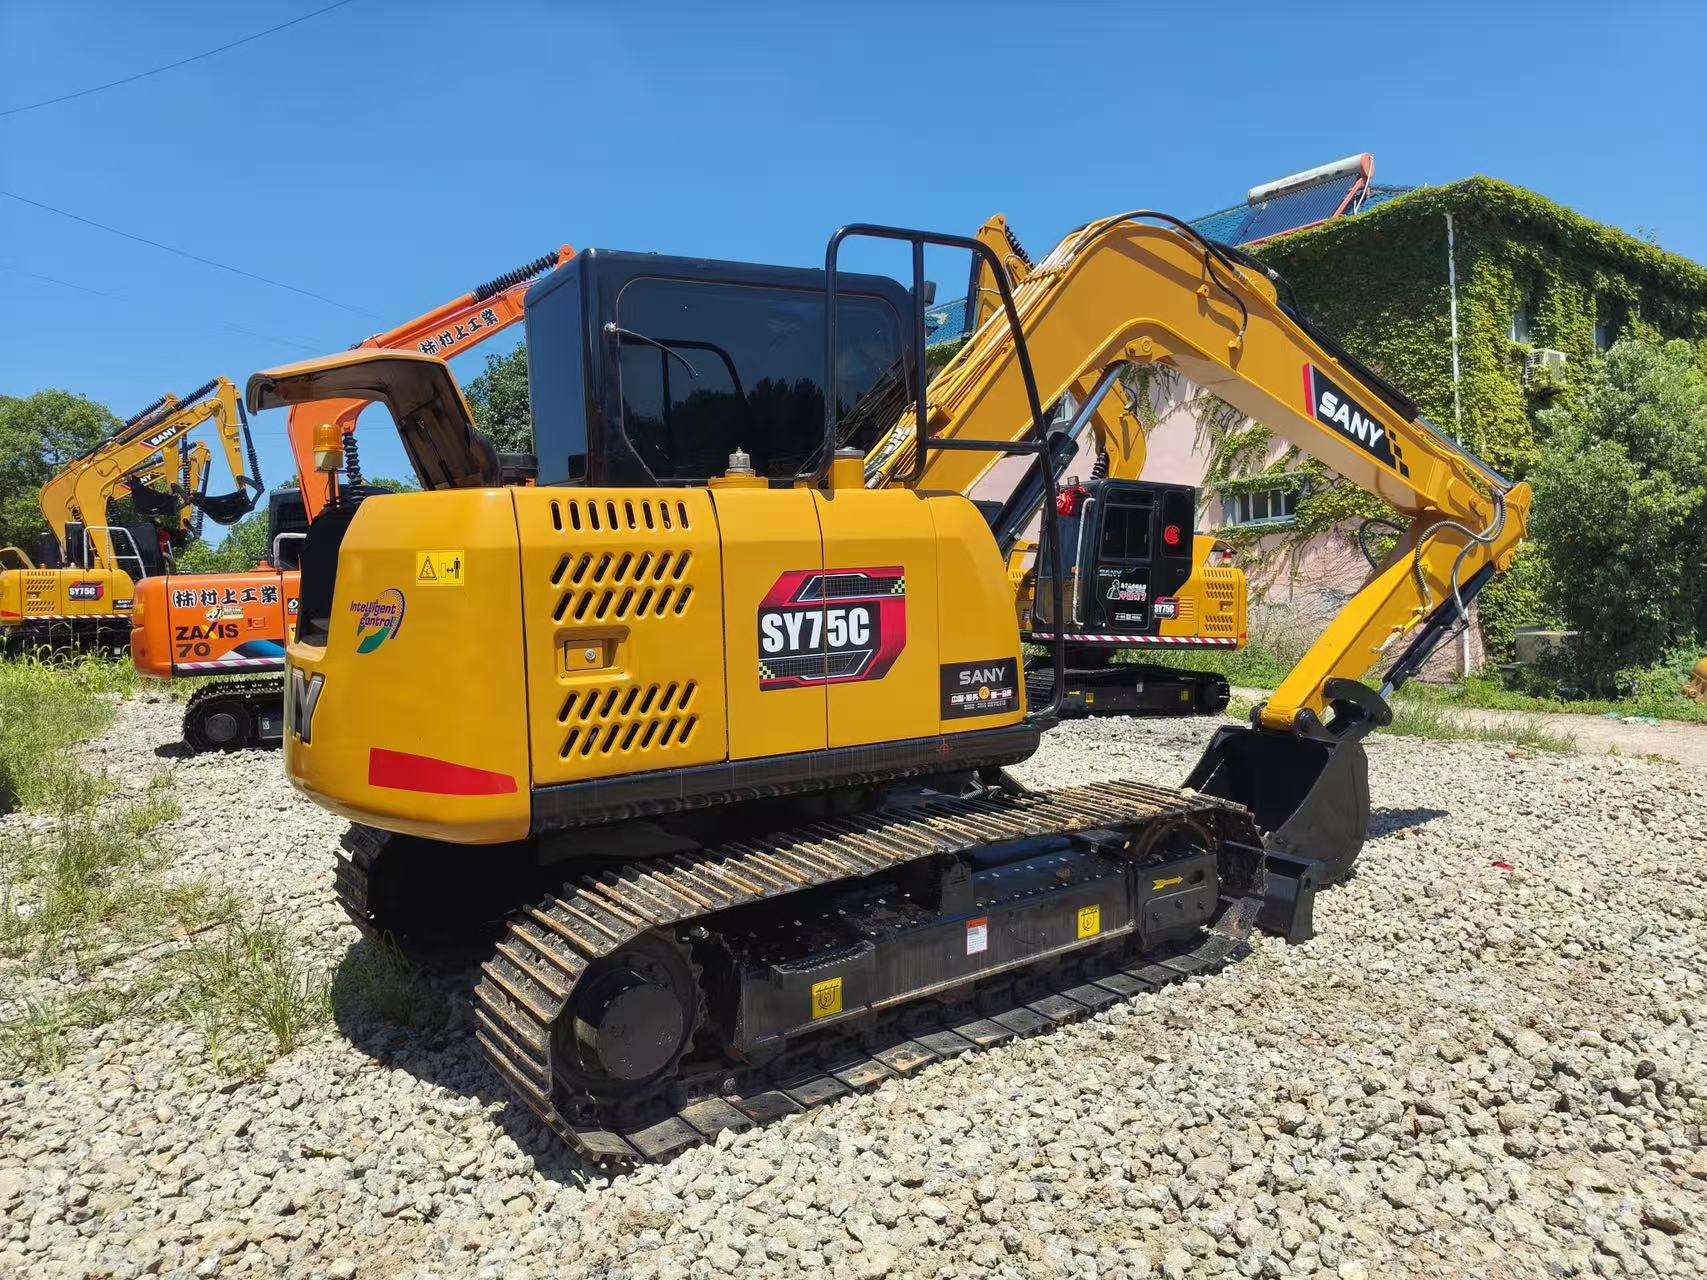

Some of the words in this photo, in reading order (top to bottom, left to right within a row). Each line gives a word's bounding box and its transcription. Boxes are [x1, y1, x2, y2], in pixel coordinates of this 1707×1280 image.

[1318, 391, 1384, 448] SANY
[150, 425, 177, 446] SANY
[69, 587, 96, 595] SY75C
[350, 599, 397, 616] Intelligent
[1153, 604, 1175, 614] SY75C
[175, 621, 239, 640] ZAXIS
[360, 616, 393, 628] control
[761, 607, 870, 653] SY75C
[175, 641, 211, 658] 70
[959, 667, 1005, 685] SANY
